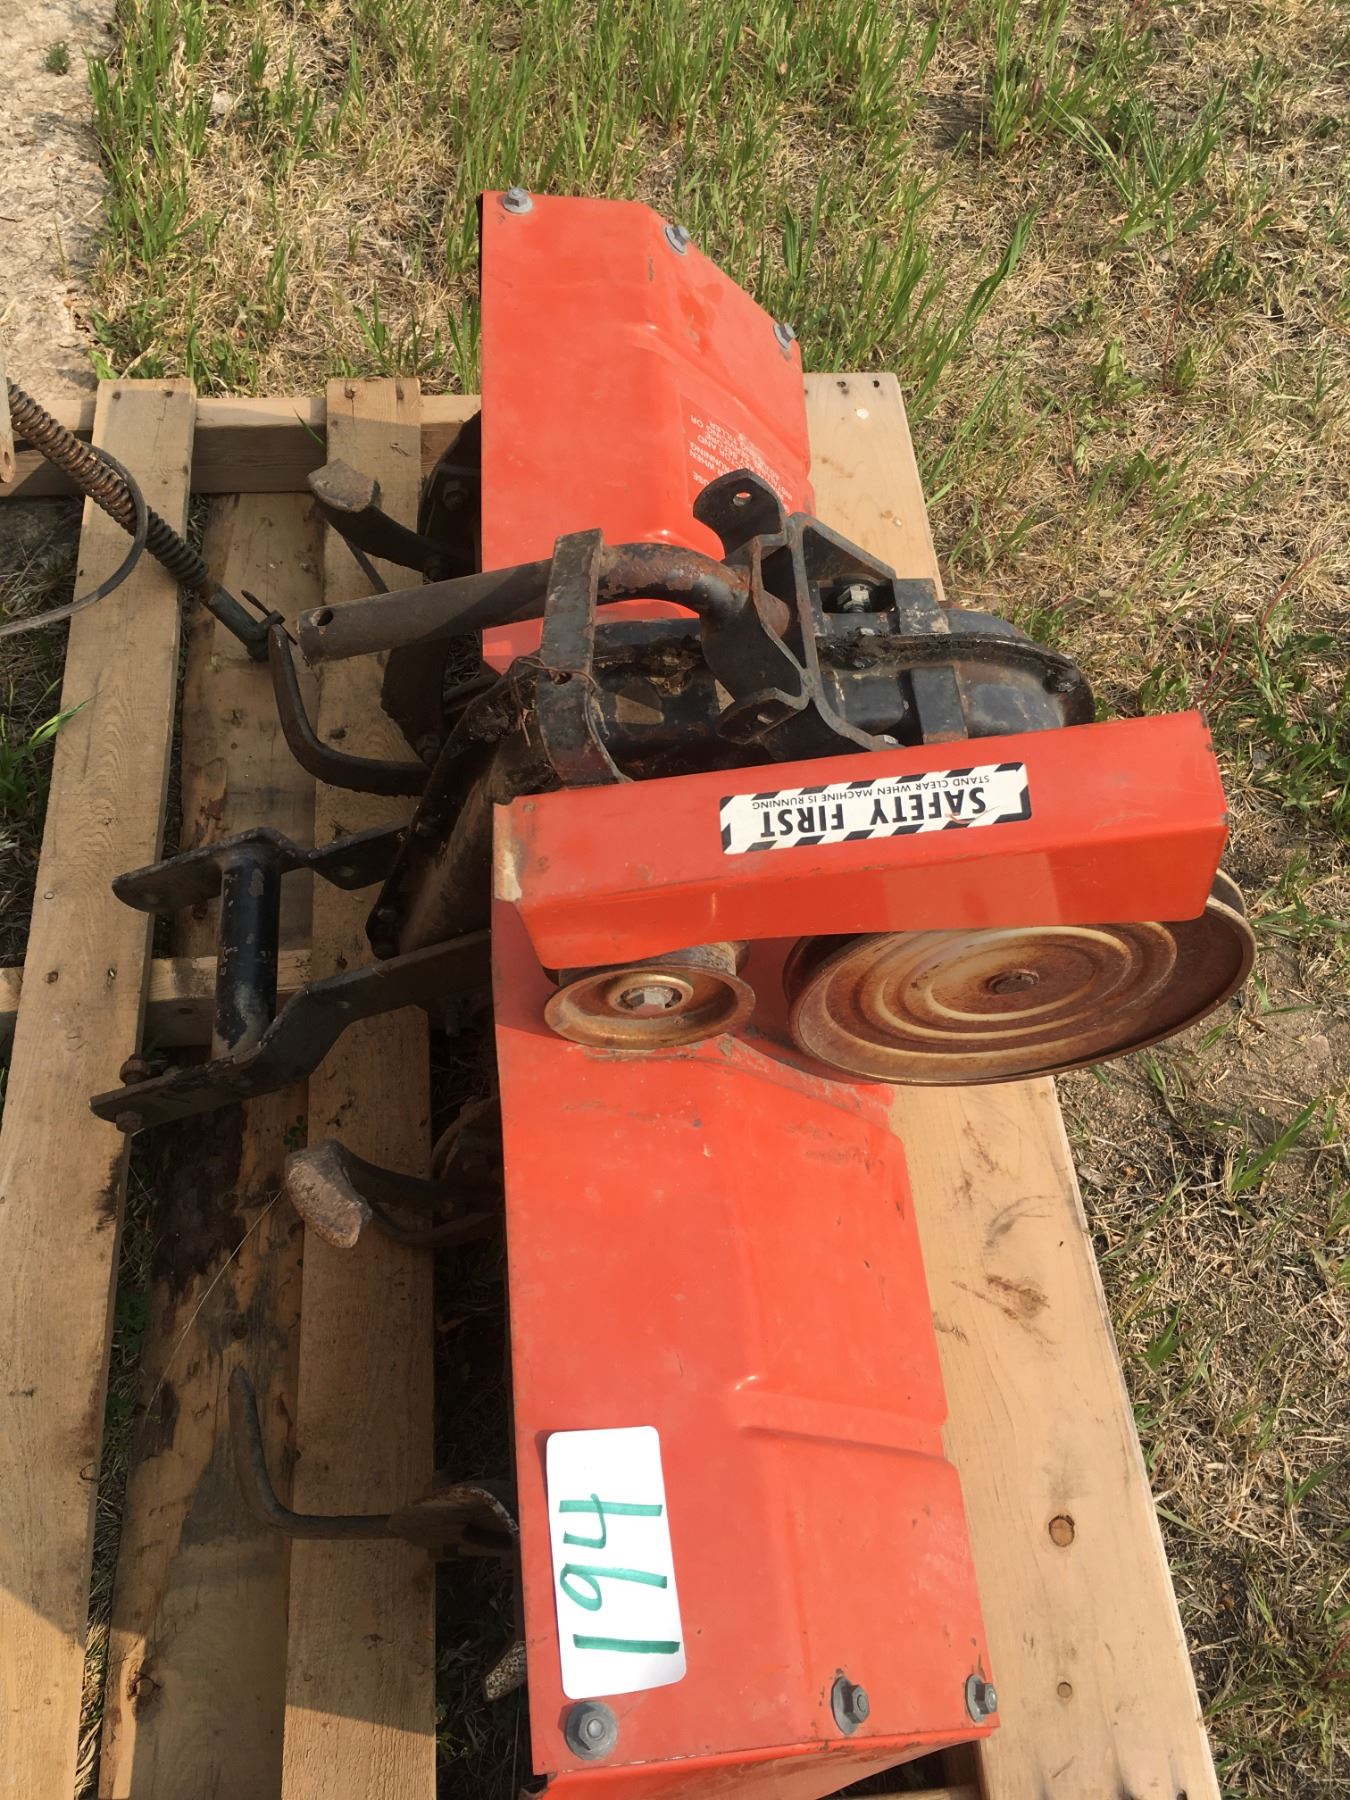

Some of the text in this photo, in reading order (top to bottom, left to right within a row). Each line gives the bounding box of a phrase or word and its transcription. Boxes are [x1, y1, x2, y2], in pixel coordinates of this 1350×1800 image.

[690, 415, 704, 428] OR
[697, 434, 716, 450] AND
[690, 450, 715, 471] WHEN
[752, 775, 990, 810] STAND CLEAR WHEN MACHINE IS RUNNING
[760, 787, 986, 838] SAFETY FIRST
[558, 1493, 680, 1654] 194
